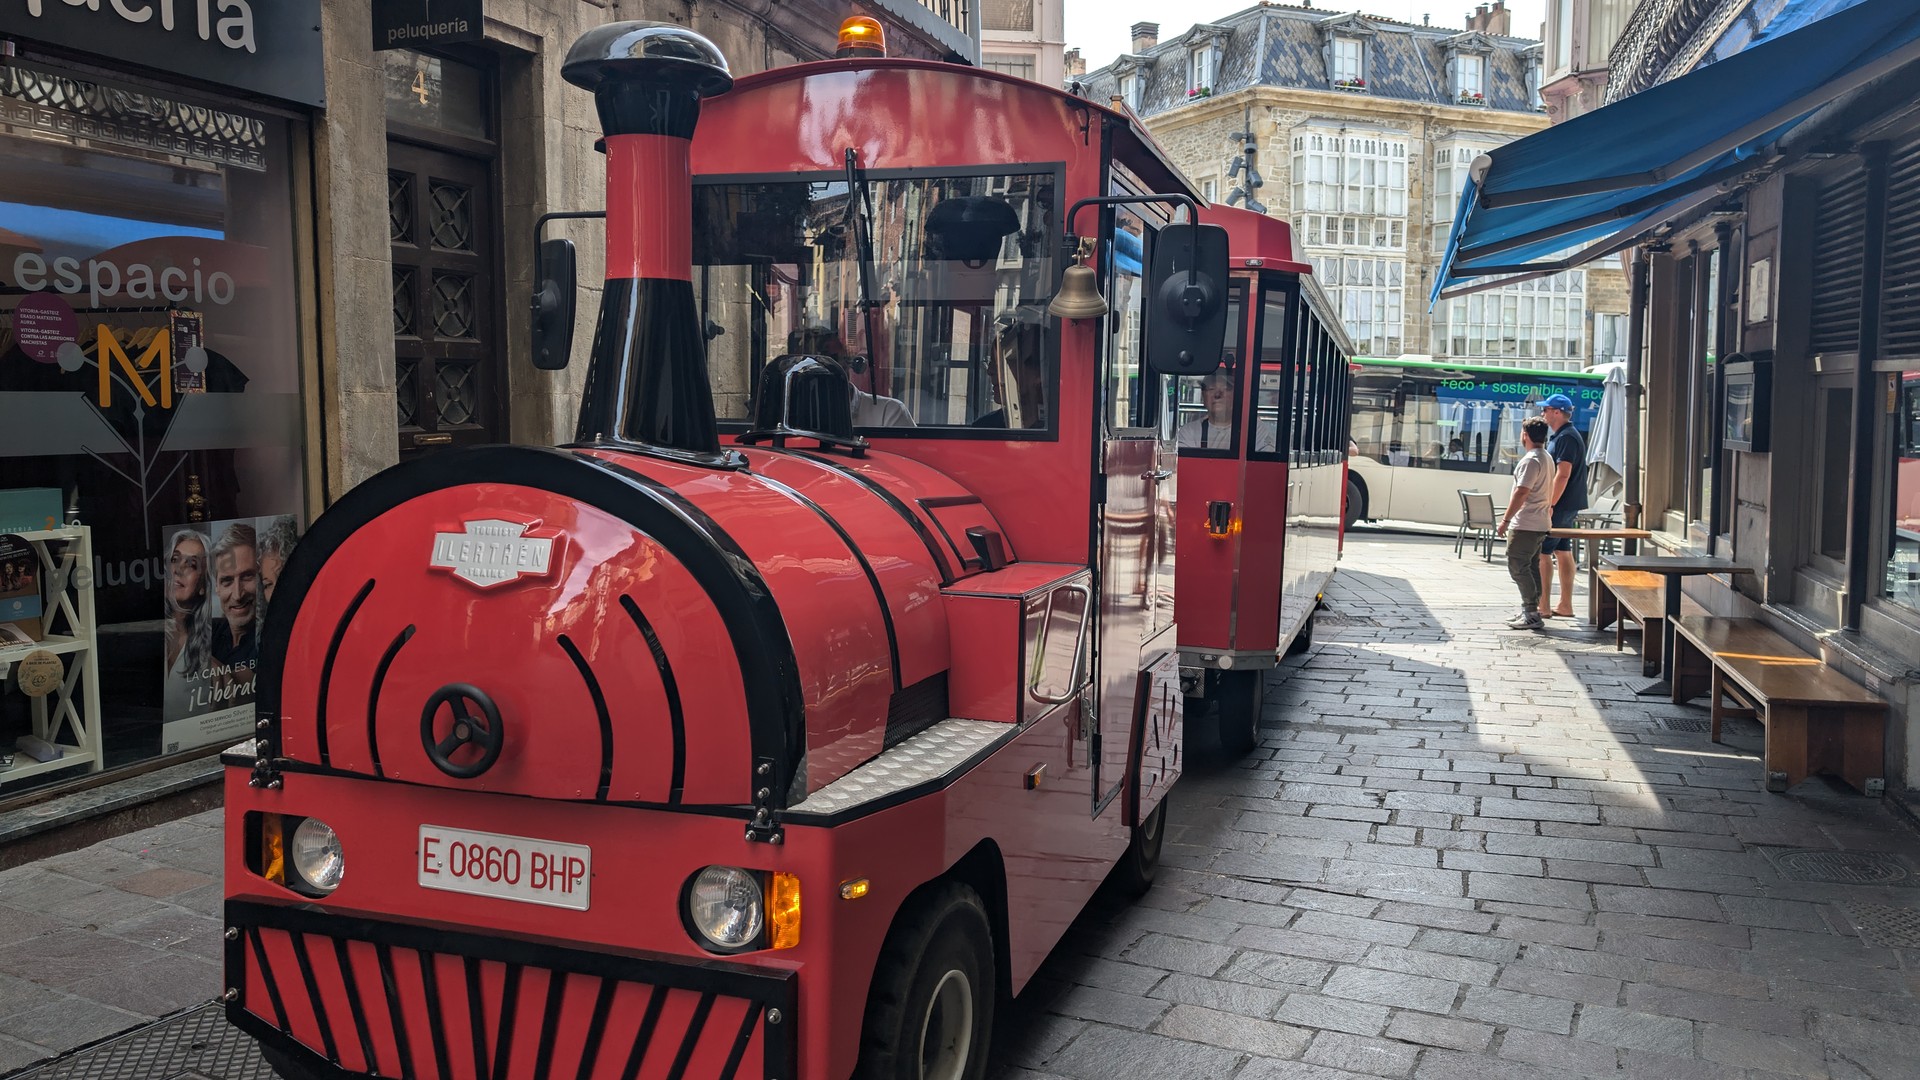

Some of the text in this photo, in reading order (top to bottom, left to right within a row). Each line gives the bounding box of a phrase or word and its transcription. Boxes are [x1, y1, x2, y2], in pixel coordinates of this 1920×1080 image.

[387, 17, 468, 44] peluquería
[411, 70, 429, 105] 4
[13, 251, 236, 308] espacio
[1492, 382, 1563, 397] sostenible
[474, 525, 515, 537] TOURIST
[437, 539, 545, 568] ILERTREN
[468, 567, 506, 579] TRAINS
[186, 671, 200, 683] LA
[202, 664, 232, 679] CANA
[234, 660, 247, 673] ES
[423, 837, 586, 894] E 0860 BHP
